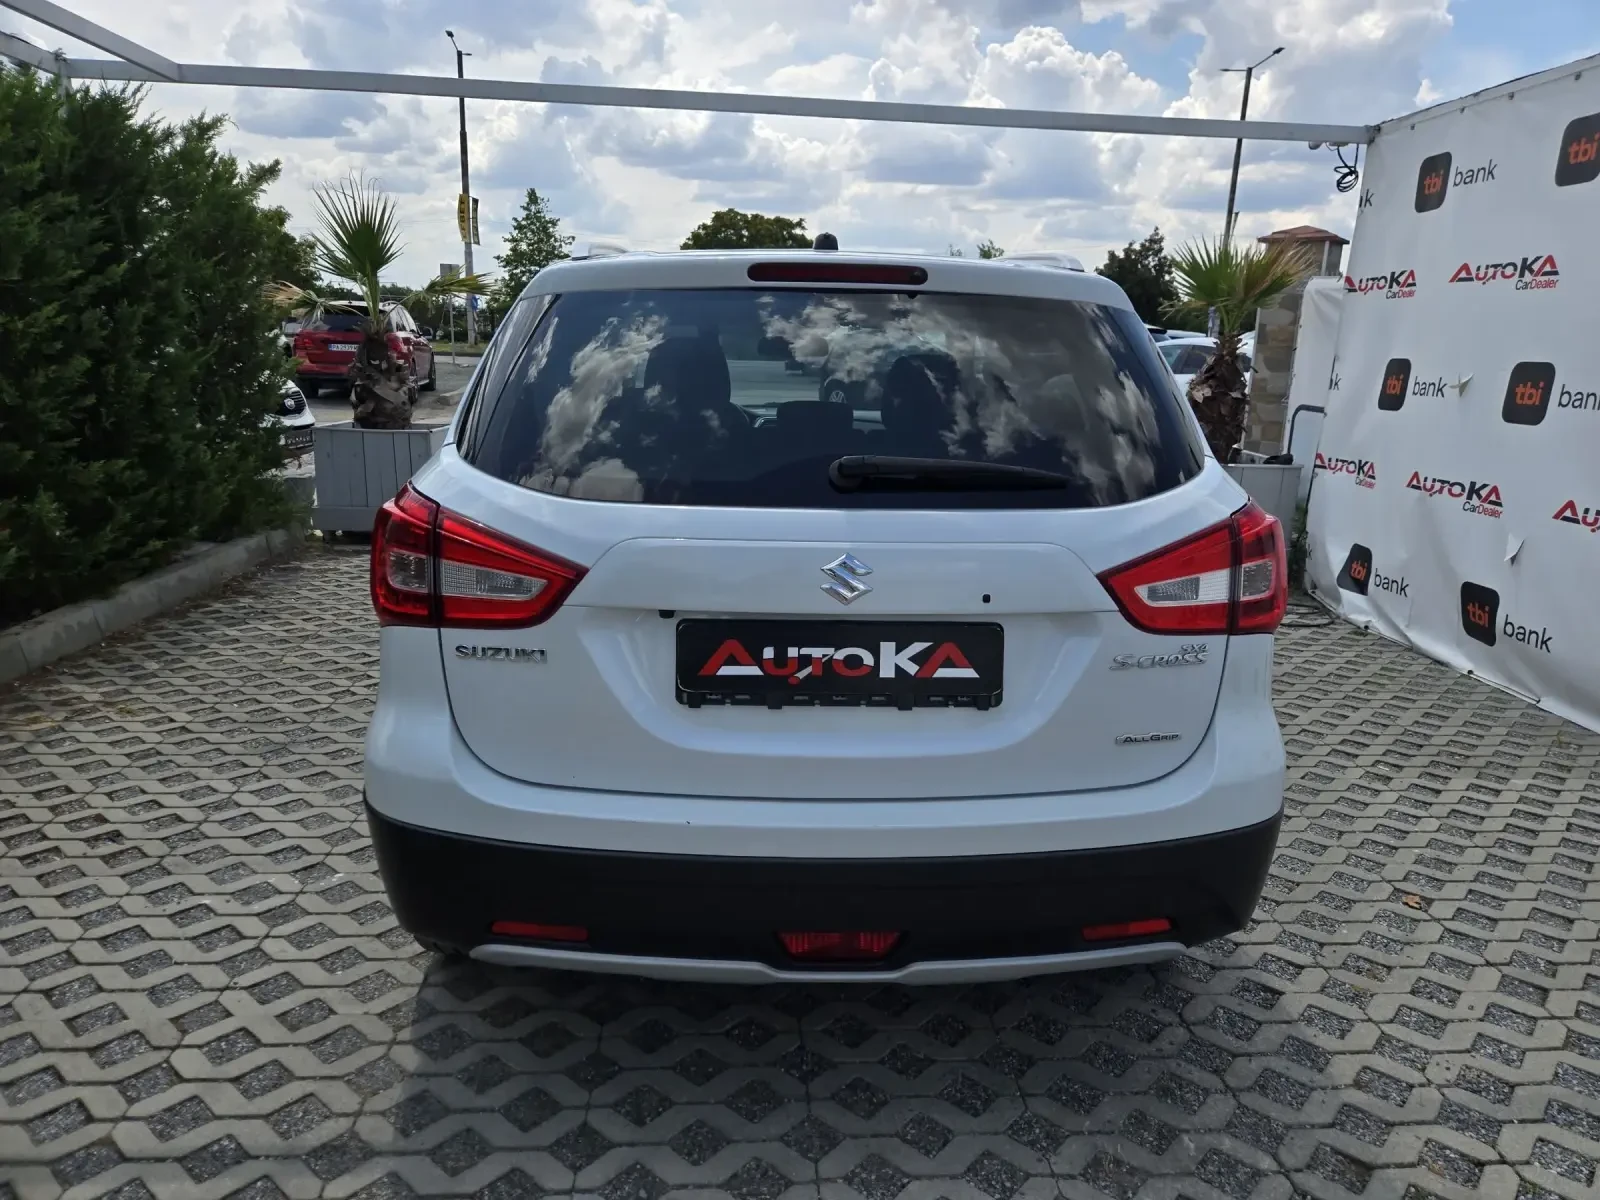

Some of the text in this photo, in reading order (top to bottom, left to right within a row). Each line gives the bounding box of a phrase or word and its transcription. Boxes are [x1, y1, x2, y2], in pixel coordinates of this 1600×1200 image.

[1569, 132, 1600, 164] tbi
[1424, 159, 1497, 195] tbi bank
[1387, 374, 1448, 399] tbi bank
[1515, 381, 1600, 411] tbi ban
[1350, 559, 1410, 598] tbi bank
[1467, 601, 1553, 654] tbi bank
[454, 643, 548, 664] SUZUKI
[1180, 643, 1209, 653] SX4
